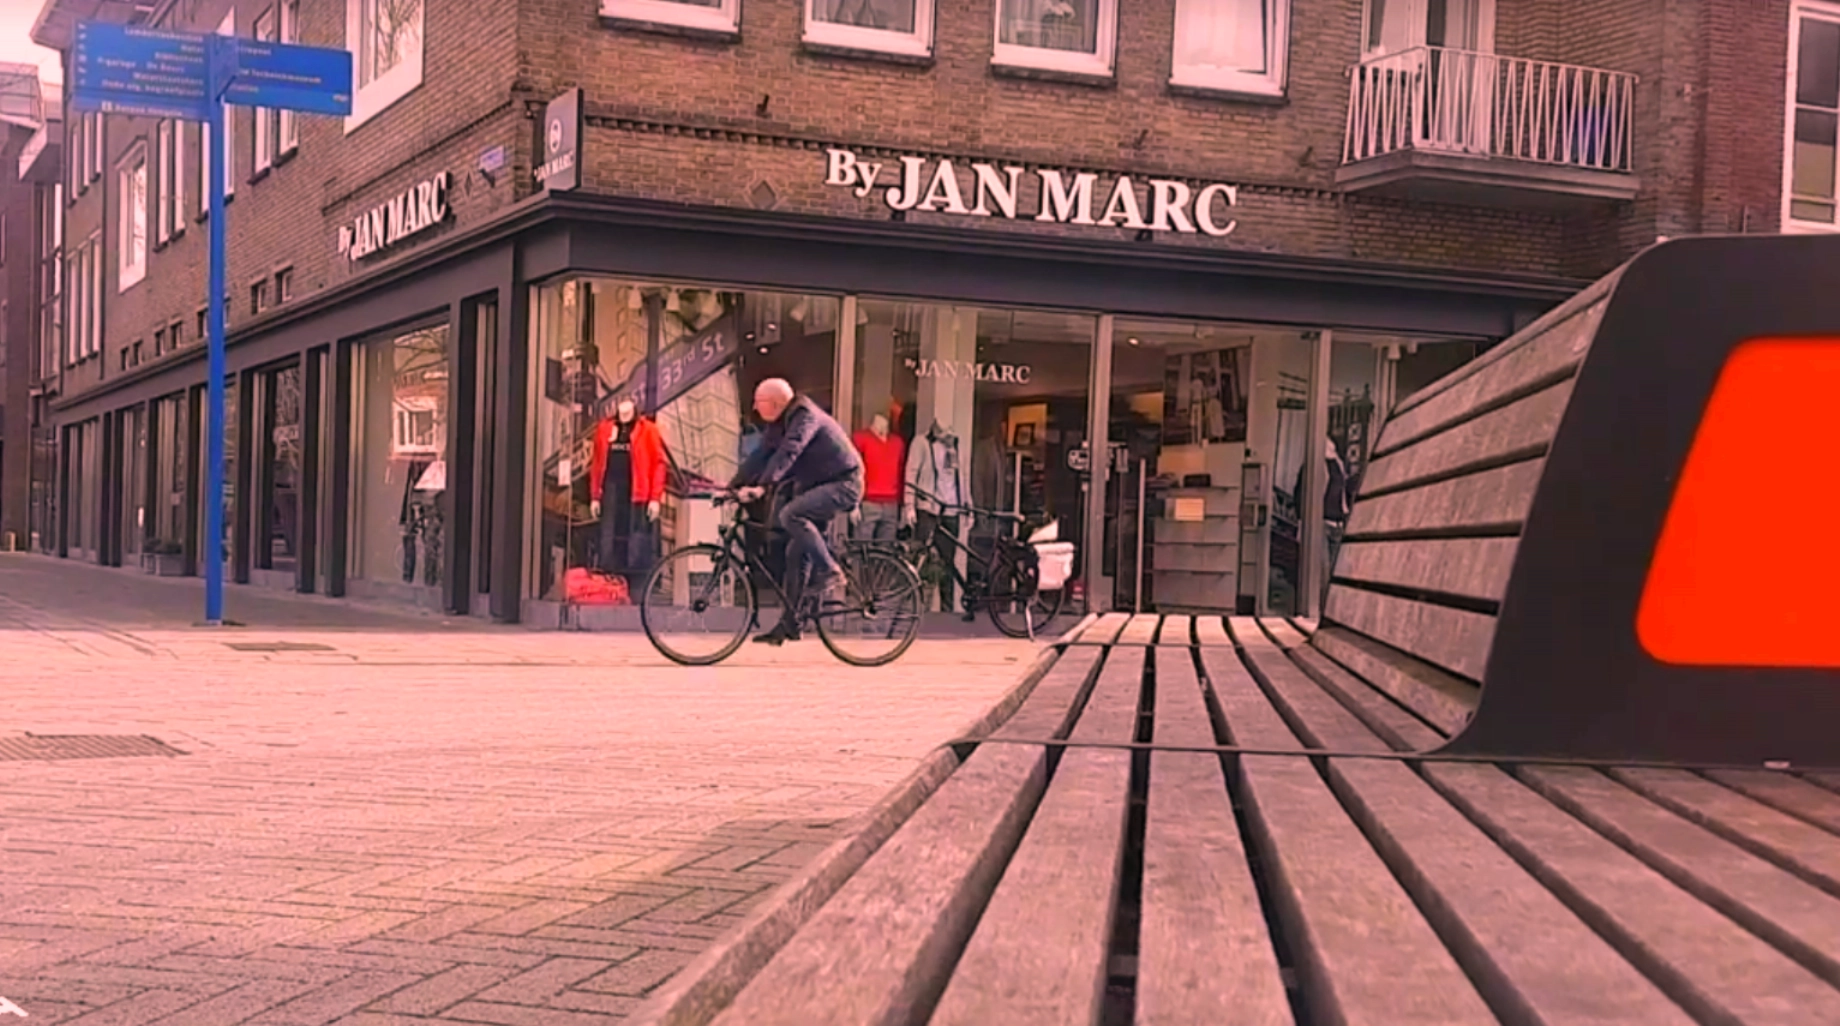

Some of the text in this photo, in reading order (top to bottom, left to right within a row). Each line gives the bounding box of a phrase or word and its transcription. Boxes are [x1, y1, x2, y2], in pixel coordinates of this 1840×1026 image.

[551, 151, 575, 175] MARC
[825, 149, 1237, 236] By JAN MARC
[351, 204, 385, 260] JAN
[386, 172, 446, 245] MARC
[661, 345, 696, 390] 33rd
[915, 359, 959, 379] JAN
[965, 361, 1031, 384] MARC
